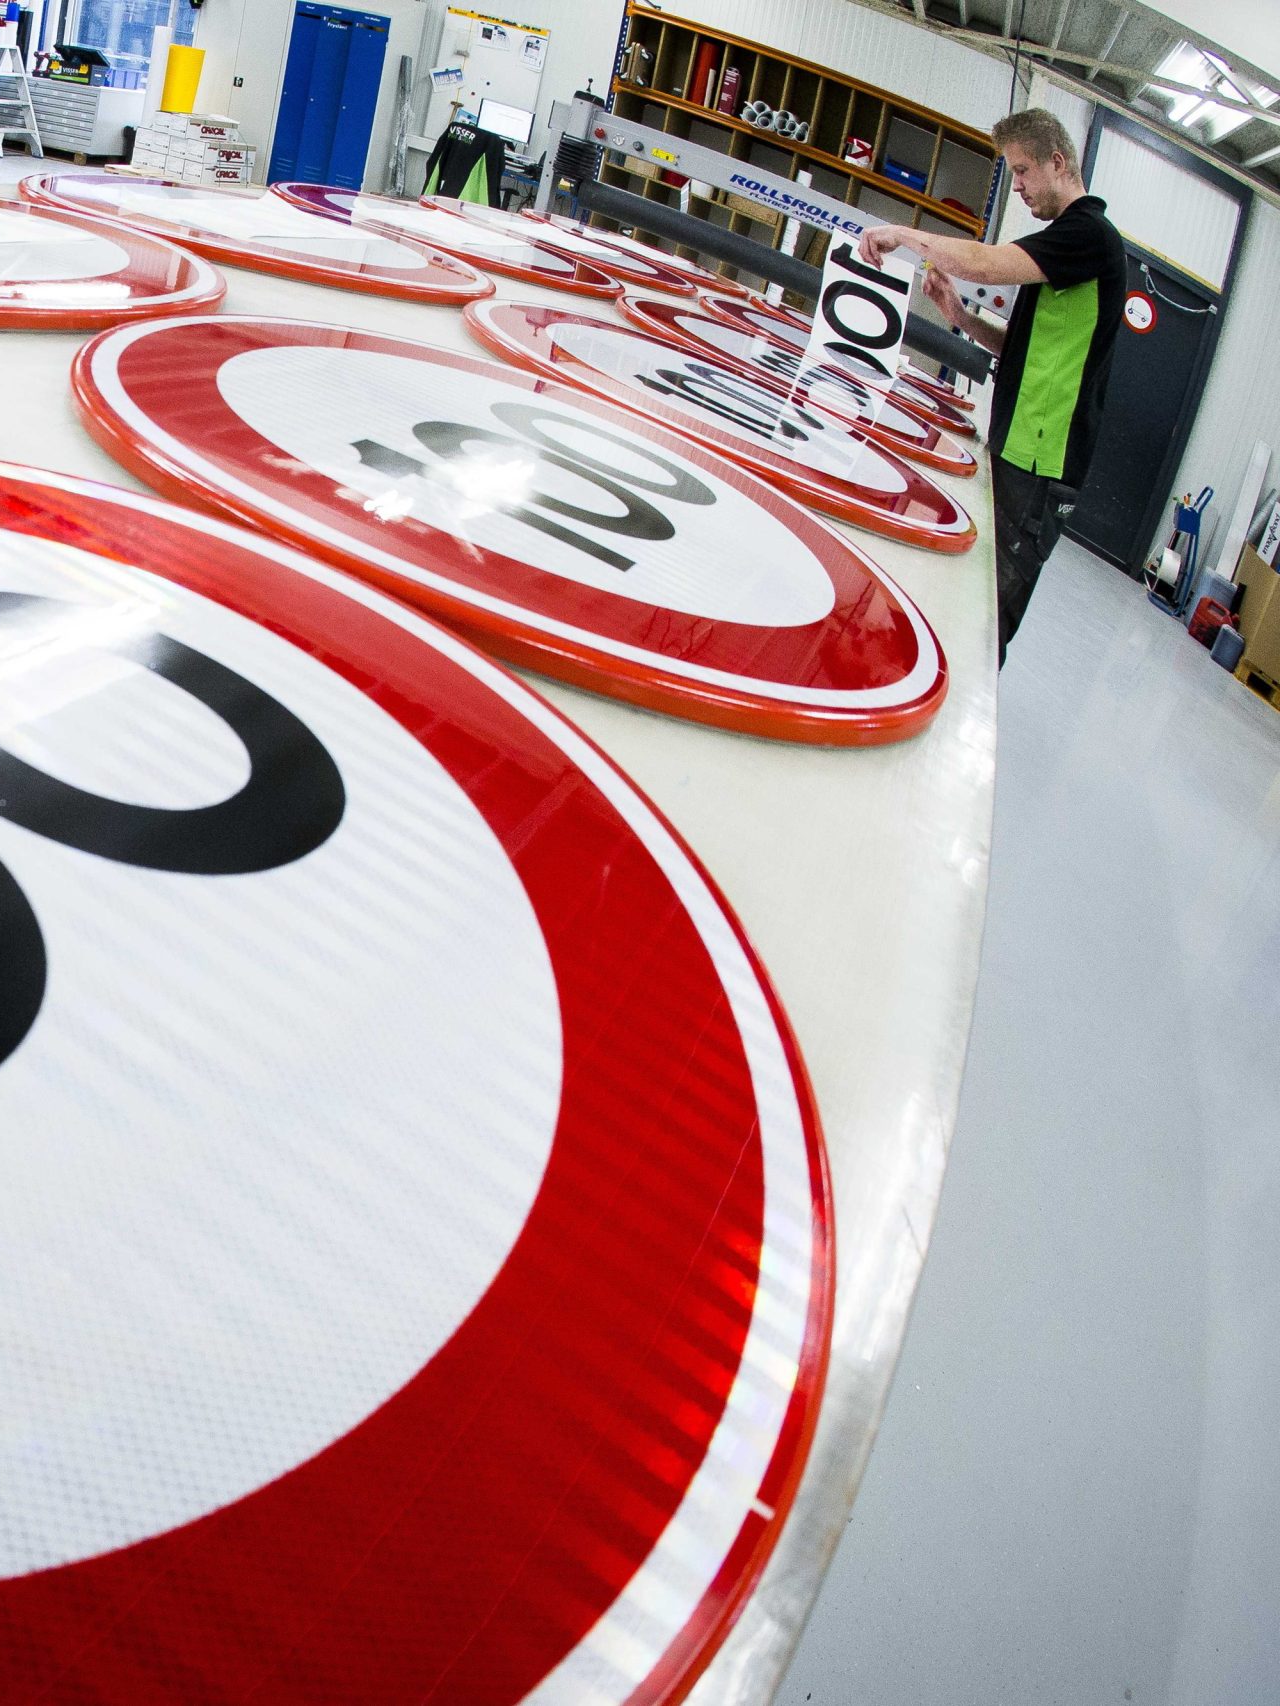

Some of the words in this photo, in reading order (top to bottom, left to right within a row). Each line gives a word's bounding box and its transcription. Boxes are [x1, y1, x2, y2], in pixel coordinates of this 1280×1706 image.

[200, 126, 226, 136] ORACAL
[215, 170, 240, 179] ORACAL
[821, 242, 910, 381] 100
[633, 363, 825, 451] 100
[349, 402, 718, 573] 100
